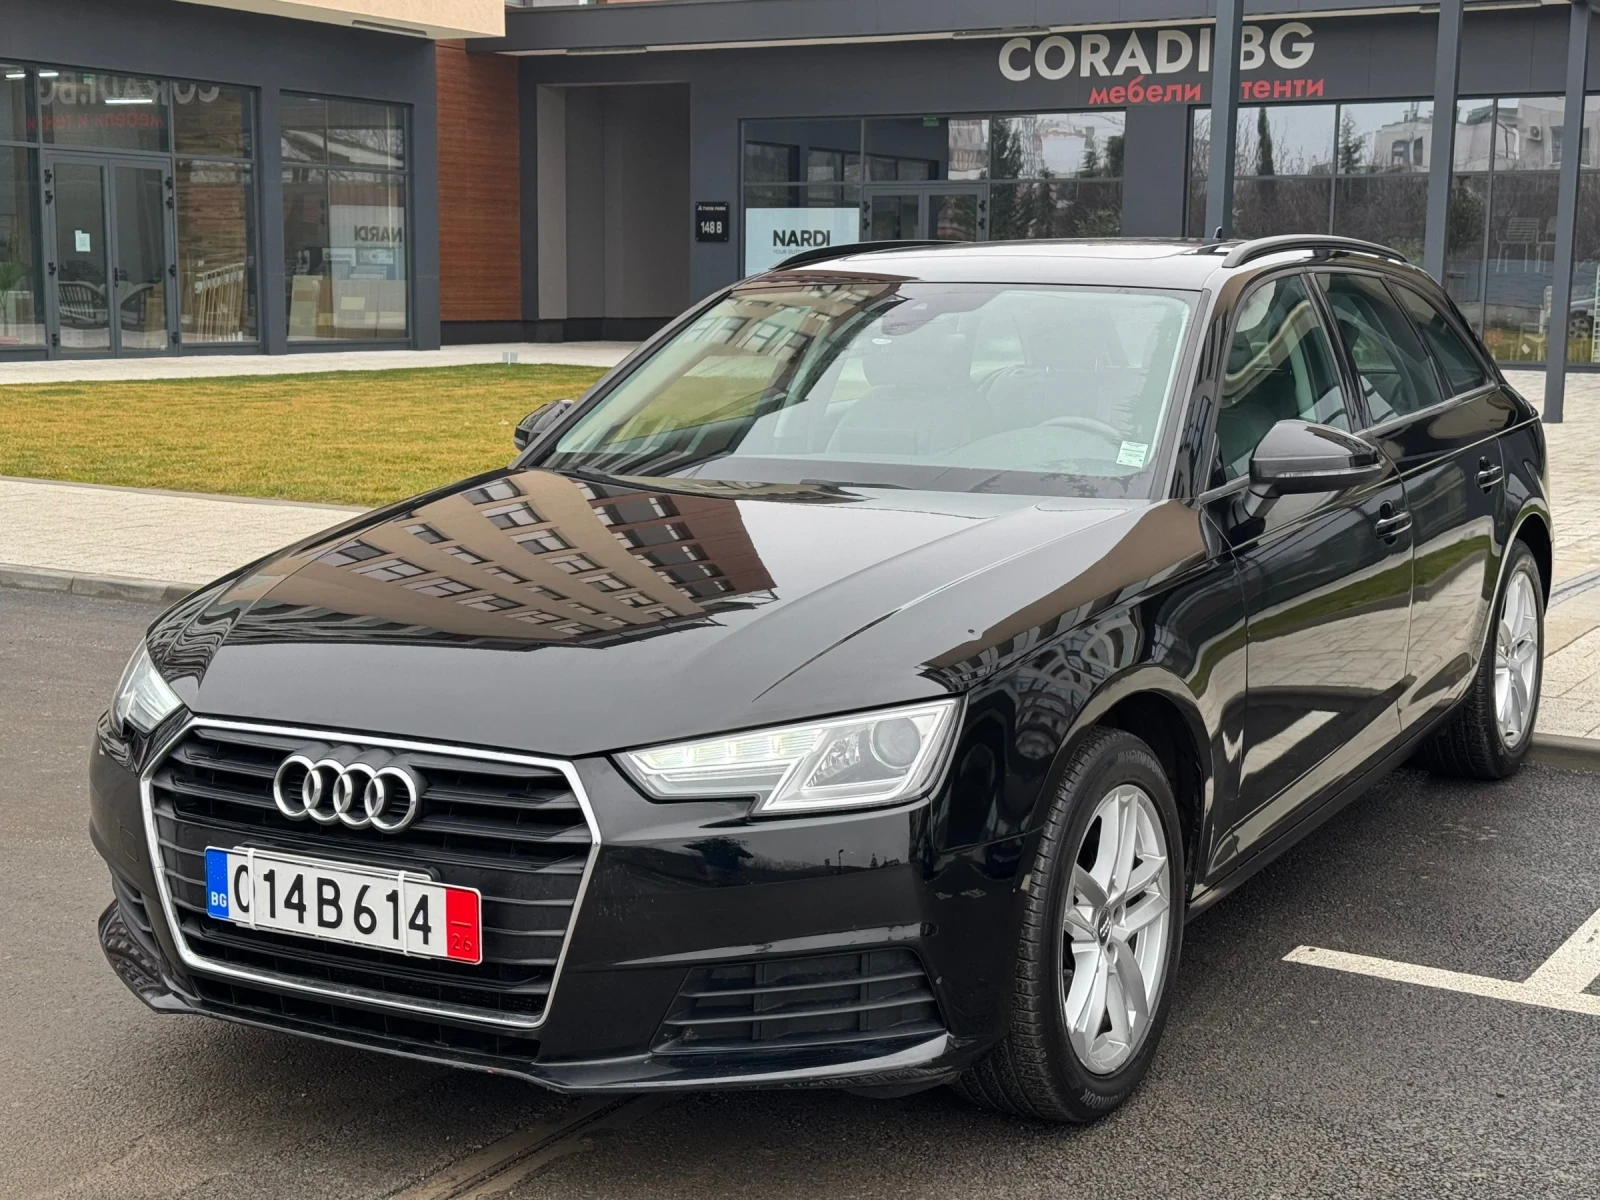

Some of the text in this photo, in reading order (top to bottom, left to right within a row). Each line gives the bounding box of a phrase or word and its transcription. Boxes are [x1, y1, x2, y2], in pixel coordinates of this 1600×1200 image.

[1088, 75, 1324, 104] мебели тенти
[701, 221, 715, 234] 148
[773, 230, 831, 247] NARDI
[211, 891, 227, 908] BG
[452, 933, 472, 952] 26
